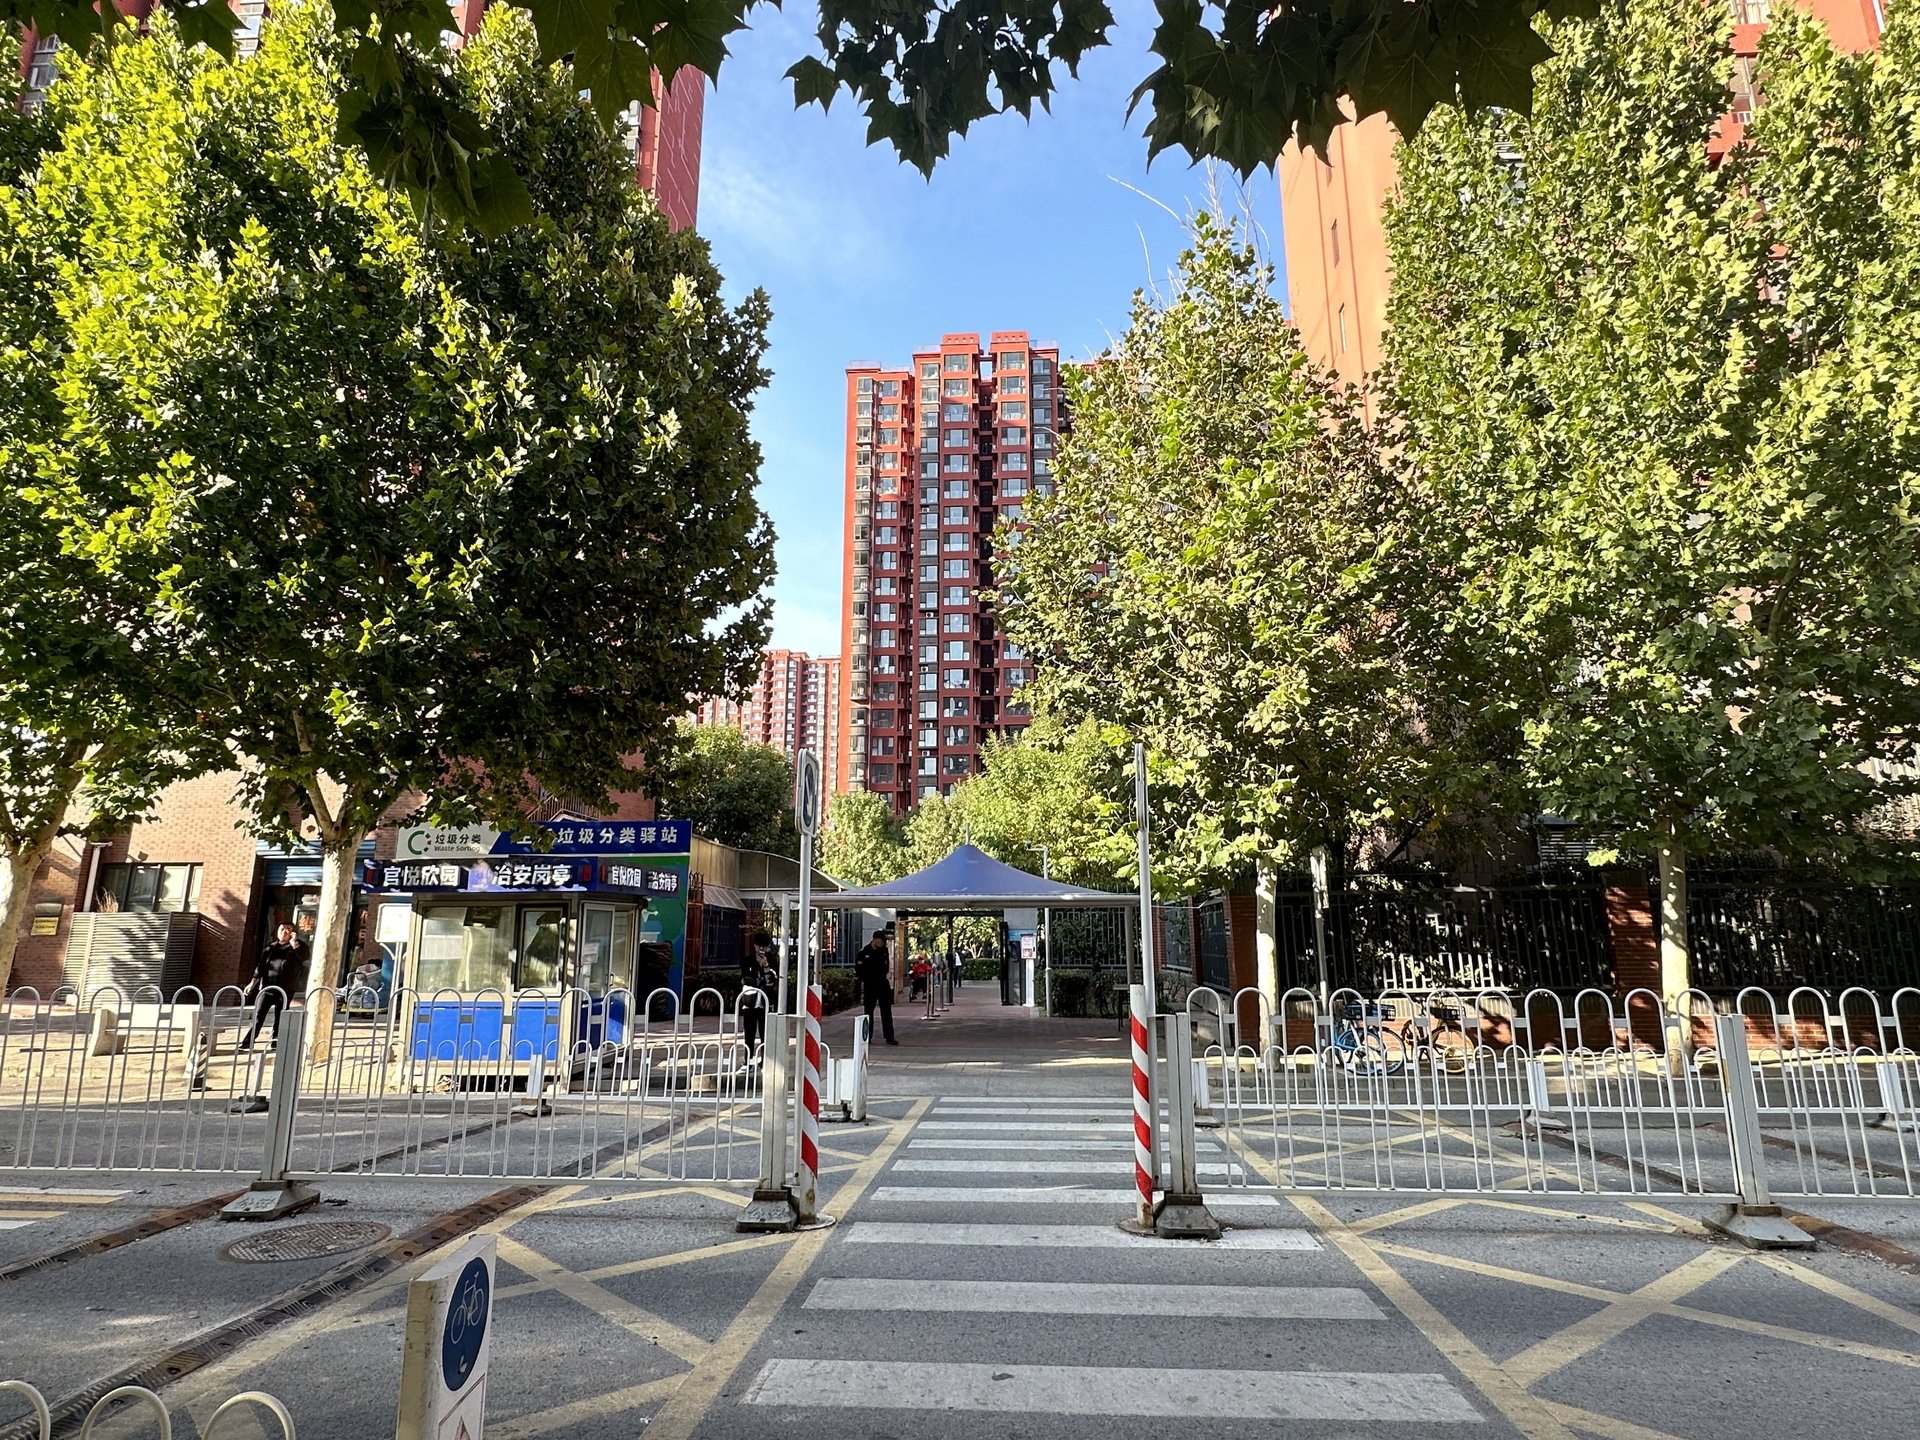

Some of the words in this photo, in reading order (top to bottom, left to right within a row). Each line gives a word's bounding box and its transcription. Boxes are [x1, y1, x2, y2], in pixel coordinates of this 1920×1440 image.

[434, 833, 482, 845] 垃圾分类
[383, 864, 460, 887] 官悦欣园
[491, 863, 573, 887] 治安岗亭
[610, 864, 642, 888] 官悦欣园
